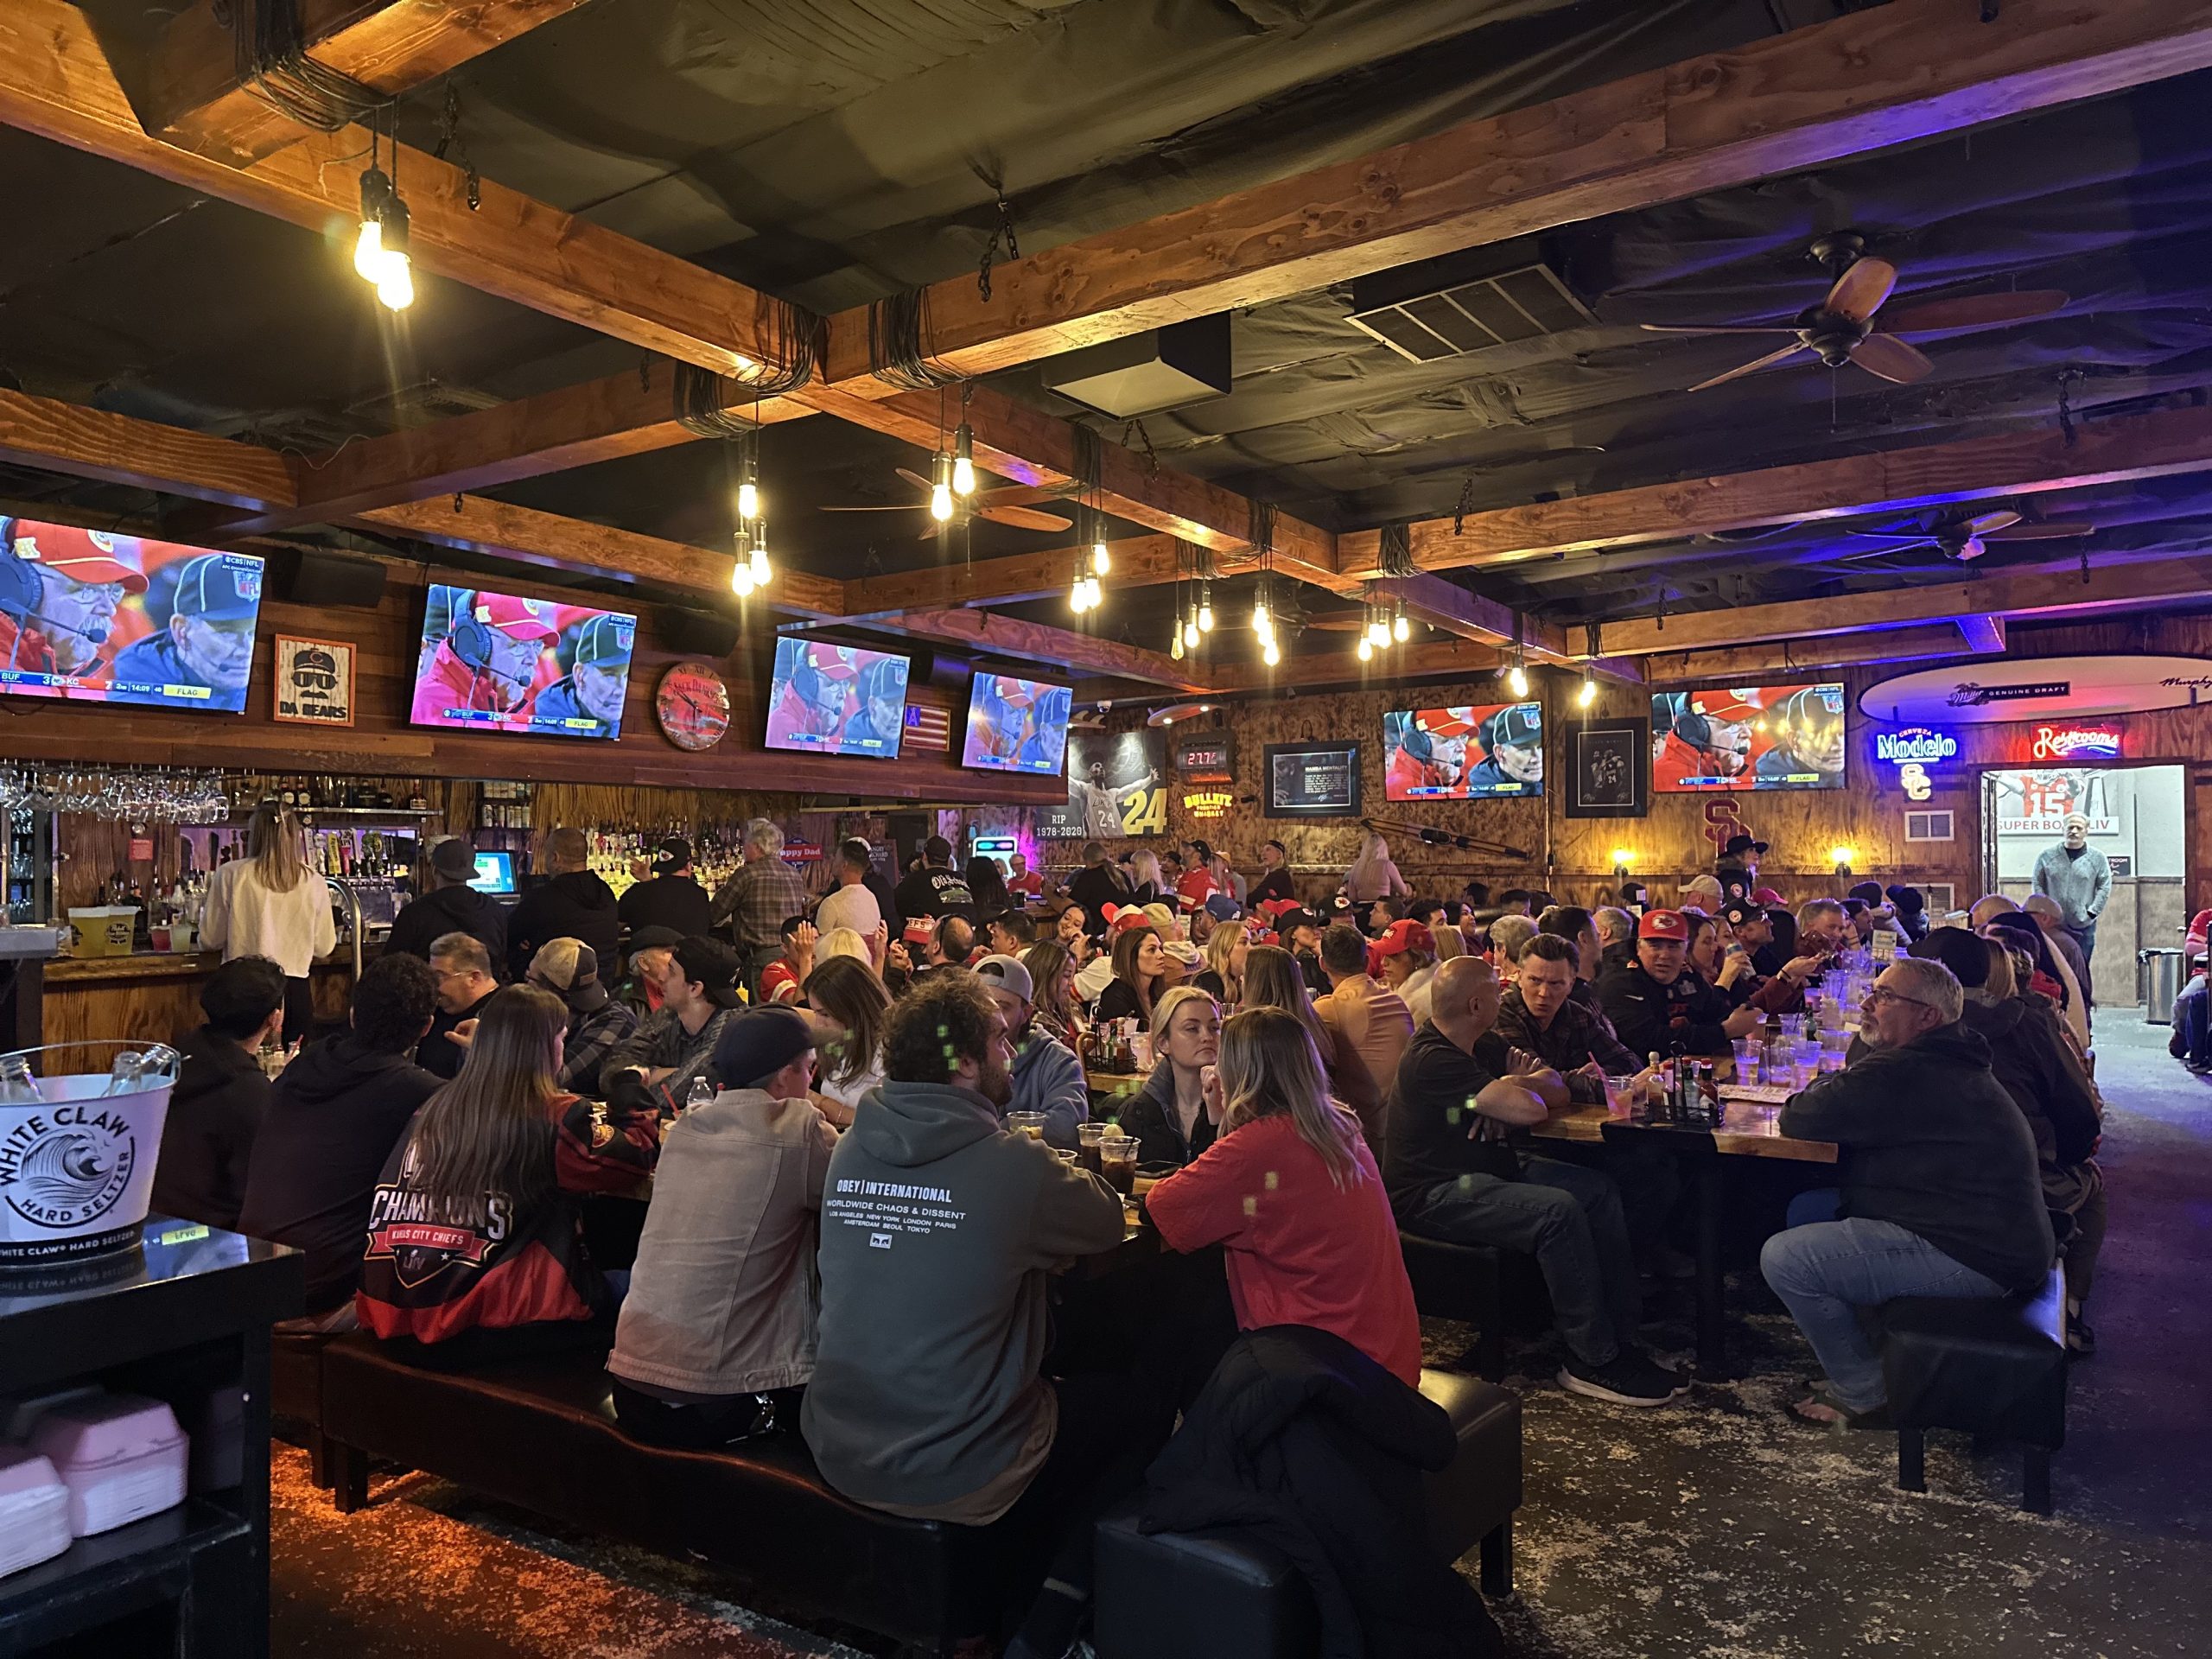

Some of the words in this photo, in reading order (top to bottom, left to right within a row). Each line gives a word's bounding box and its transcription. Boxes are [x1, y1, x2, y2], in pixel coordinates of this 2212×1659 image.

[1, 672, 20, 681] BUF
[42, 675, 50, 684] 3
[67, 677, 79, 686] KC
[105, 681, 112, 690] 7
[131, 683, 150, 692] 14:09
[176, 688, 199, 696] FLAG
[1952, 690, 1985, 704] Miller
[279, 701, 298, 715] DA
[302, 703, 346, 719] BEARS
[907, 707, 918, 727] A
[1898, 728, 1932, 738] CERVEZA
[1877, 733, 1957, 759] Modelo
[2033, 727, 2120, 759] Restrooms
[1184, 792, 1233, 810] BULLEIT
[2031, 791, 2066, 817] 15
[1052, 815, 1066, 824] RIP
[1097, 810, 1116, 829] 24
[1122, 788, 1168, 835] 24
[1037, 826, 1083, 836] 1978-2020
[909, 918, 926, 929] EFS
[0, 1116, 49, 1187] WHITE
[54, 1106, 130, 1138] CLAW
[21, 1198, 73, 1223] HARD
[81, 1152, 130, 1217] SELTZER
[836, 1179, 861, 1193] OBEY
[865, 1181, 952, 1203] INTERNATIONAL
[826, 1199, 874, 1211] WORLDWIDE
[875, 1203, 909, 1214] CHAOS
[921, 1208, 966, 1220] DISSENT
[843, 1218, 880, 1228] AMSTERDAM
[882, 1223, 904, 1231] SEOUL
[907, 1225, 931, 1234] TOKYO
[903, 1217, 932, 1227] LONDON
[935, 1221, 957, 1230] PARIS
[69, 1240, 99, 1251] HARD
[412, 1230, 430, 1240] CITY
[432, 1232, 464, 1245] CHIEFS
